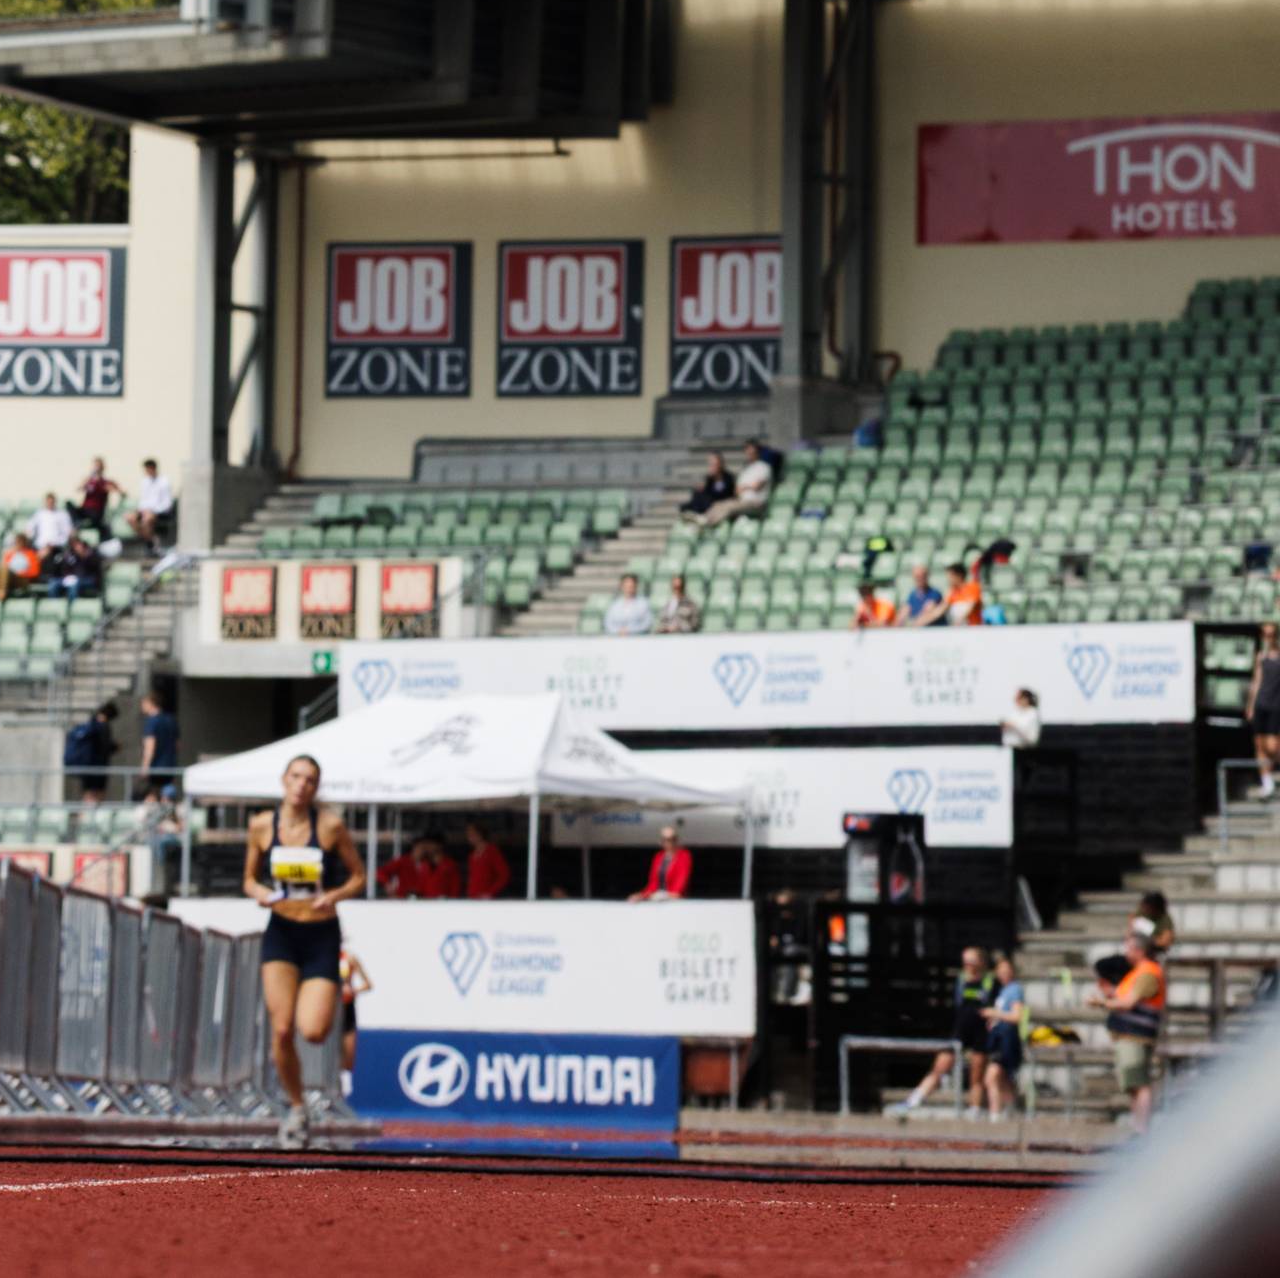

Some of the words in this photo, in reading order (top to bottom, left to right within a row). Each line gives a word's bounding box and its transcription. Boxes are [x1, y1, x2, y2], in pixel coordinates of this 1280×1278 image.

[1070, 123, 1258, 196] THON
[1111, 199, 1238, 232] HOTELS
[339, 256, 448, 333] JOB
[509, 255, 620, 333] JOB
[327, 347, 467, 393] ZONE
[498, 346, 638, 392] ZONE
[670, 343, 775, 390] ZON
[491, 953, 563, 972] DIAMOND
[676, 933, 722, 954] OSLO
[488, 977, 546, 996] LEAGUE
[658, 958, 737, 980] BISLETT
[665, 983, 731, 1004] GAMES
[474, 1052, 656, 1106] HYUNDAI
